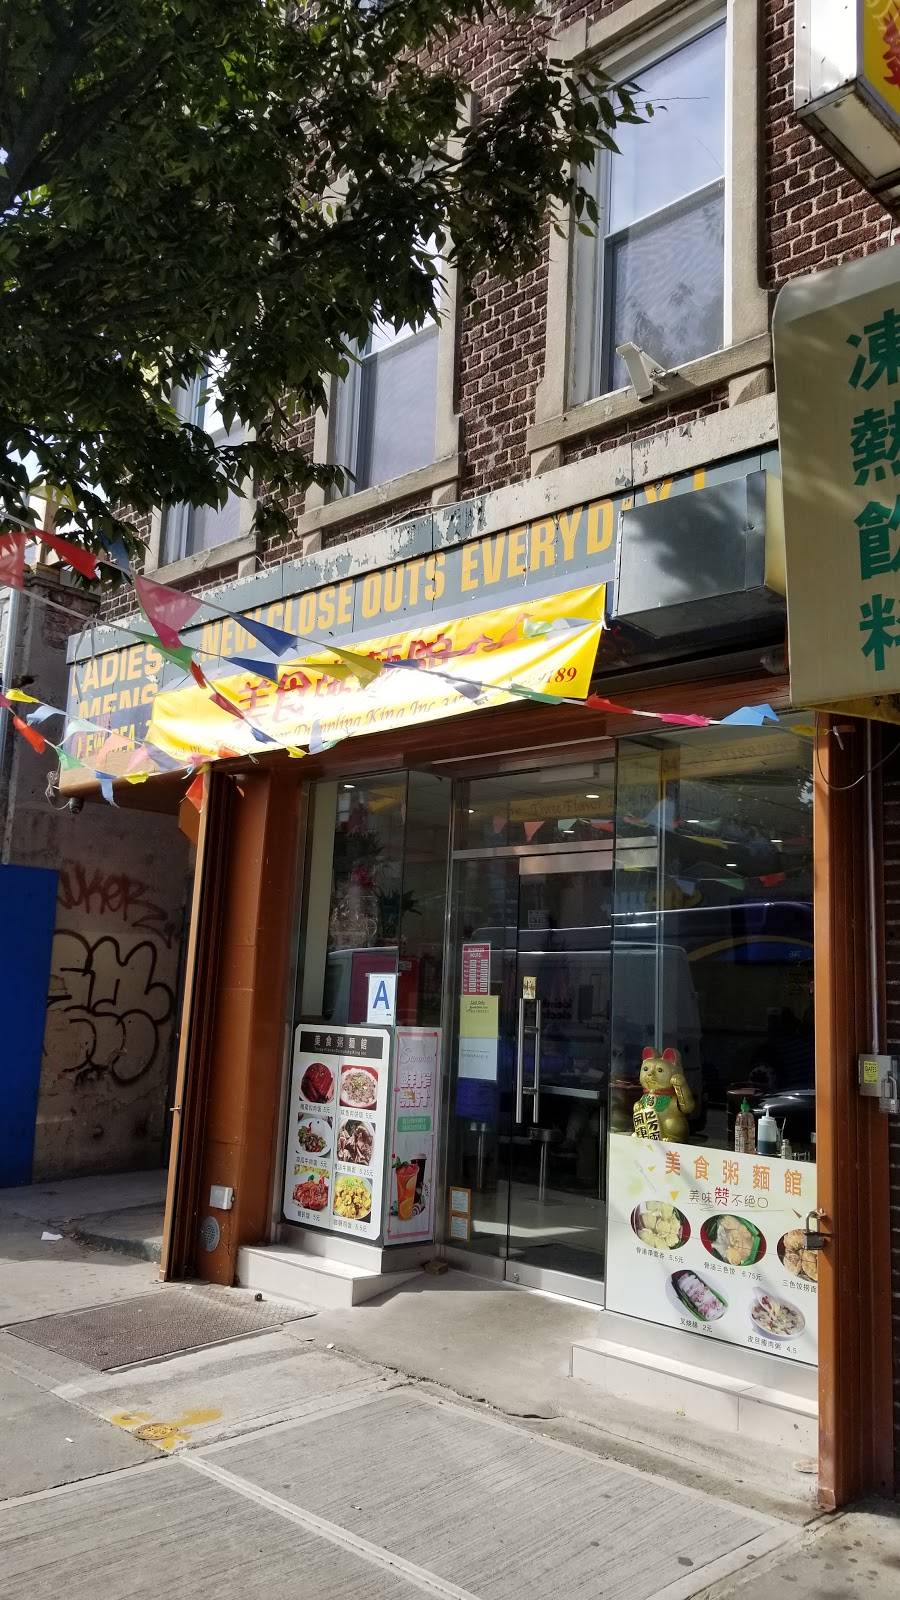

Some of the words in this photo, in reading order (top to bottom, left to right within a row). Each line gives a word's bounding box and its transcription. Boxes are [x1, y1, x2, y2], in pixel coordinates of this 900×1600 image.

[362, 552, 446, 619] OUTS
[71, 643, 163, 697] LADIES
[373, 980, 390, 1010] A
[665, 1150, 803, 1197] 美食粥麵館
